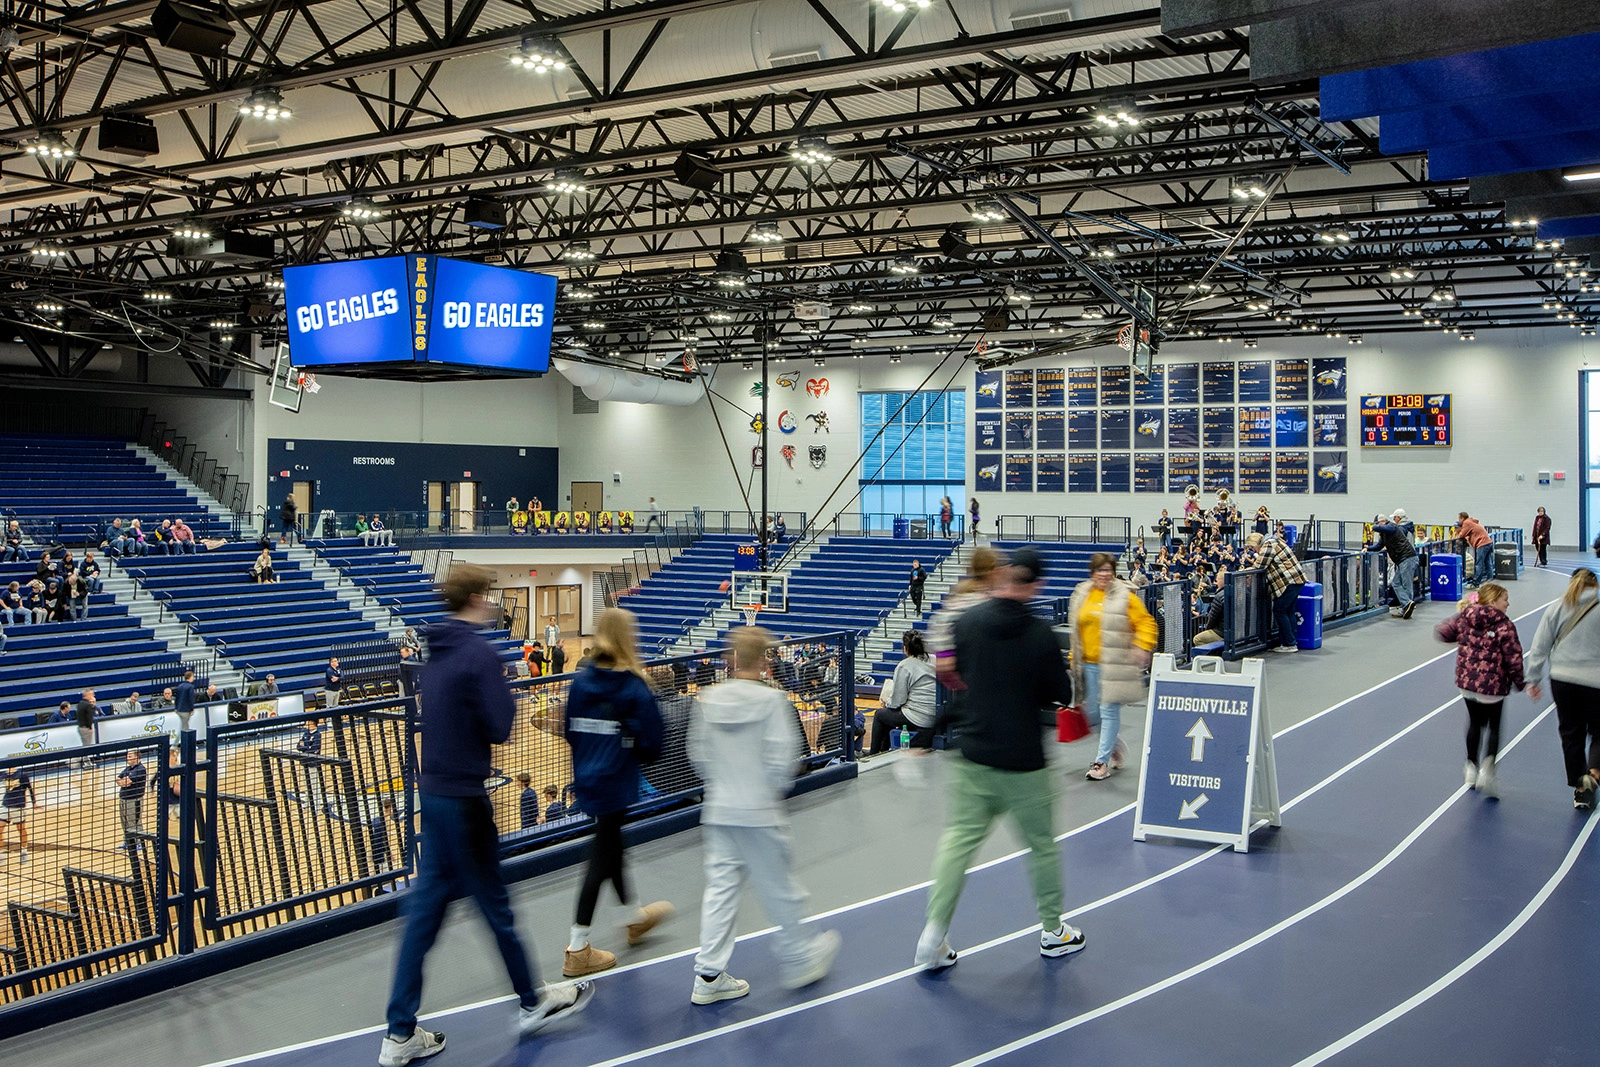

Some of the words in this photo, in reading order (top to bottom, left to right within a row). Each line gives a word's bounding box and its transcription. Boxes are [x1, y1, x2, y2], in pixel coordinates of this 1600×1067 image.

[415, 258, 426, 350] EAGLES
[296, 303, 323, 333] GO
[327, 288, 399, 327] EAGLES
[444, 302, 470, 329] GO
[475, 302, 544, 328] EAGLES
[1392, 396, 1422, 406] 13:08
[1376, 415, 1384, 426] 0
[1438, 414, 1445, 426] 0
[1368, 432, 1375, 441] 0
[1438, 431, 1445, 440] 0
[352, 456, 396, 466] RESTROOMS
[1158, 696, 1248, 716] HUDSONVILLE
[1169, 773, 1221, 789] VISITORS
